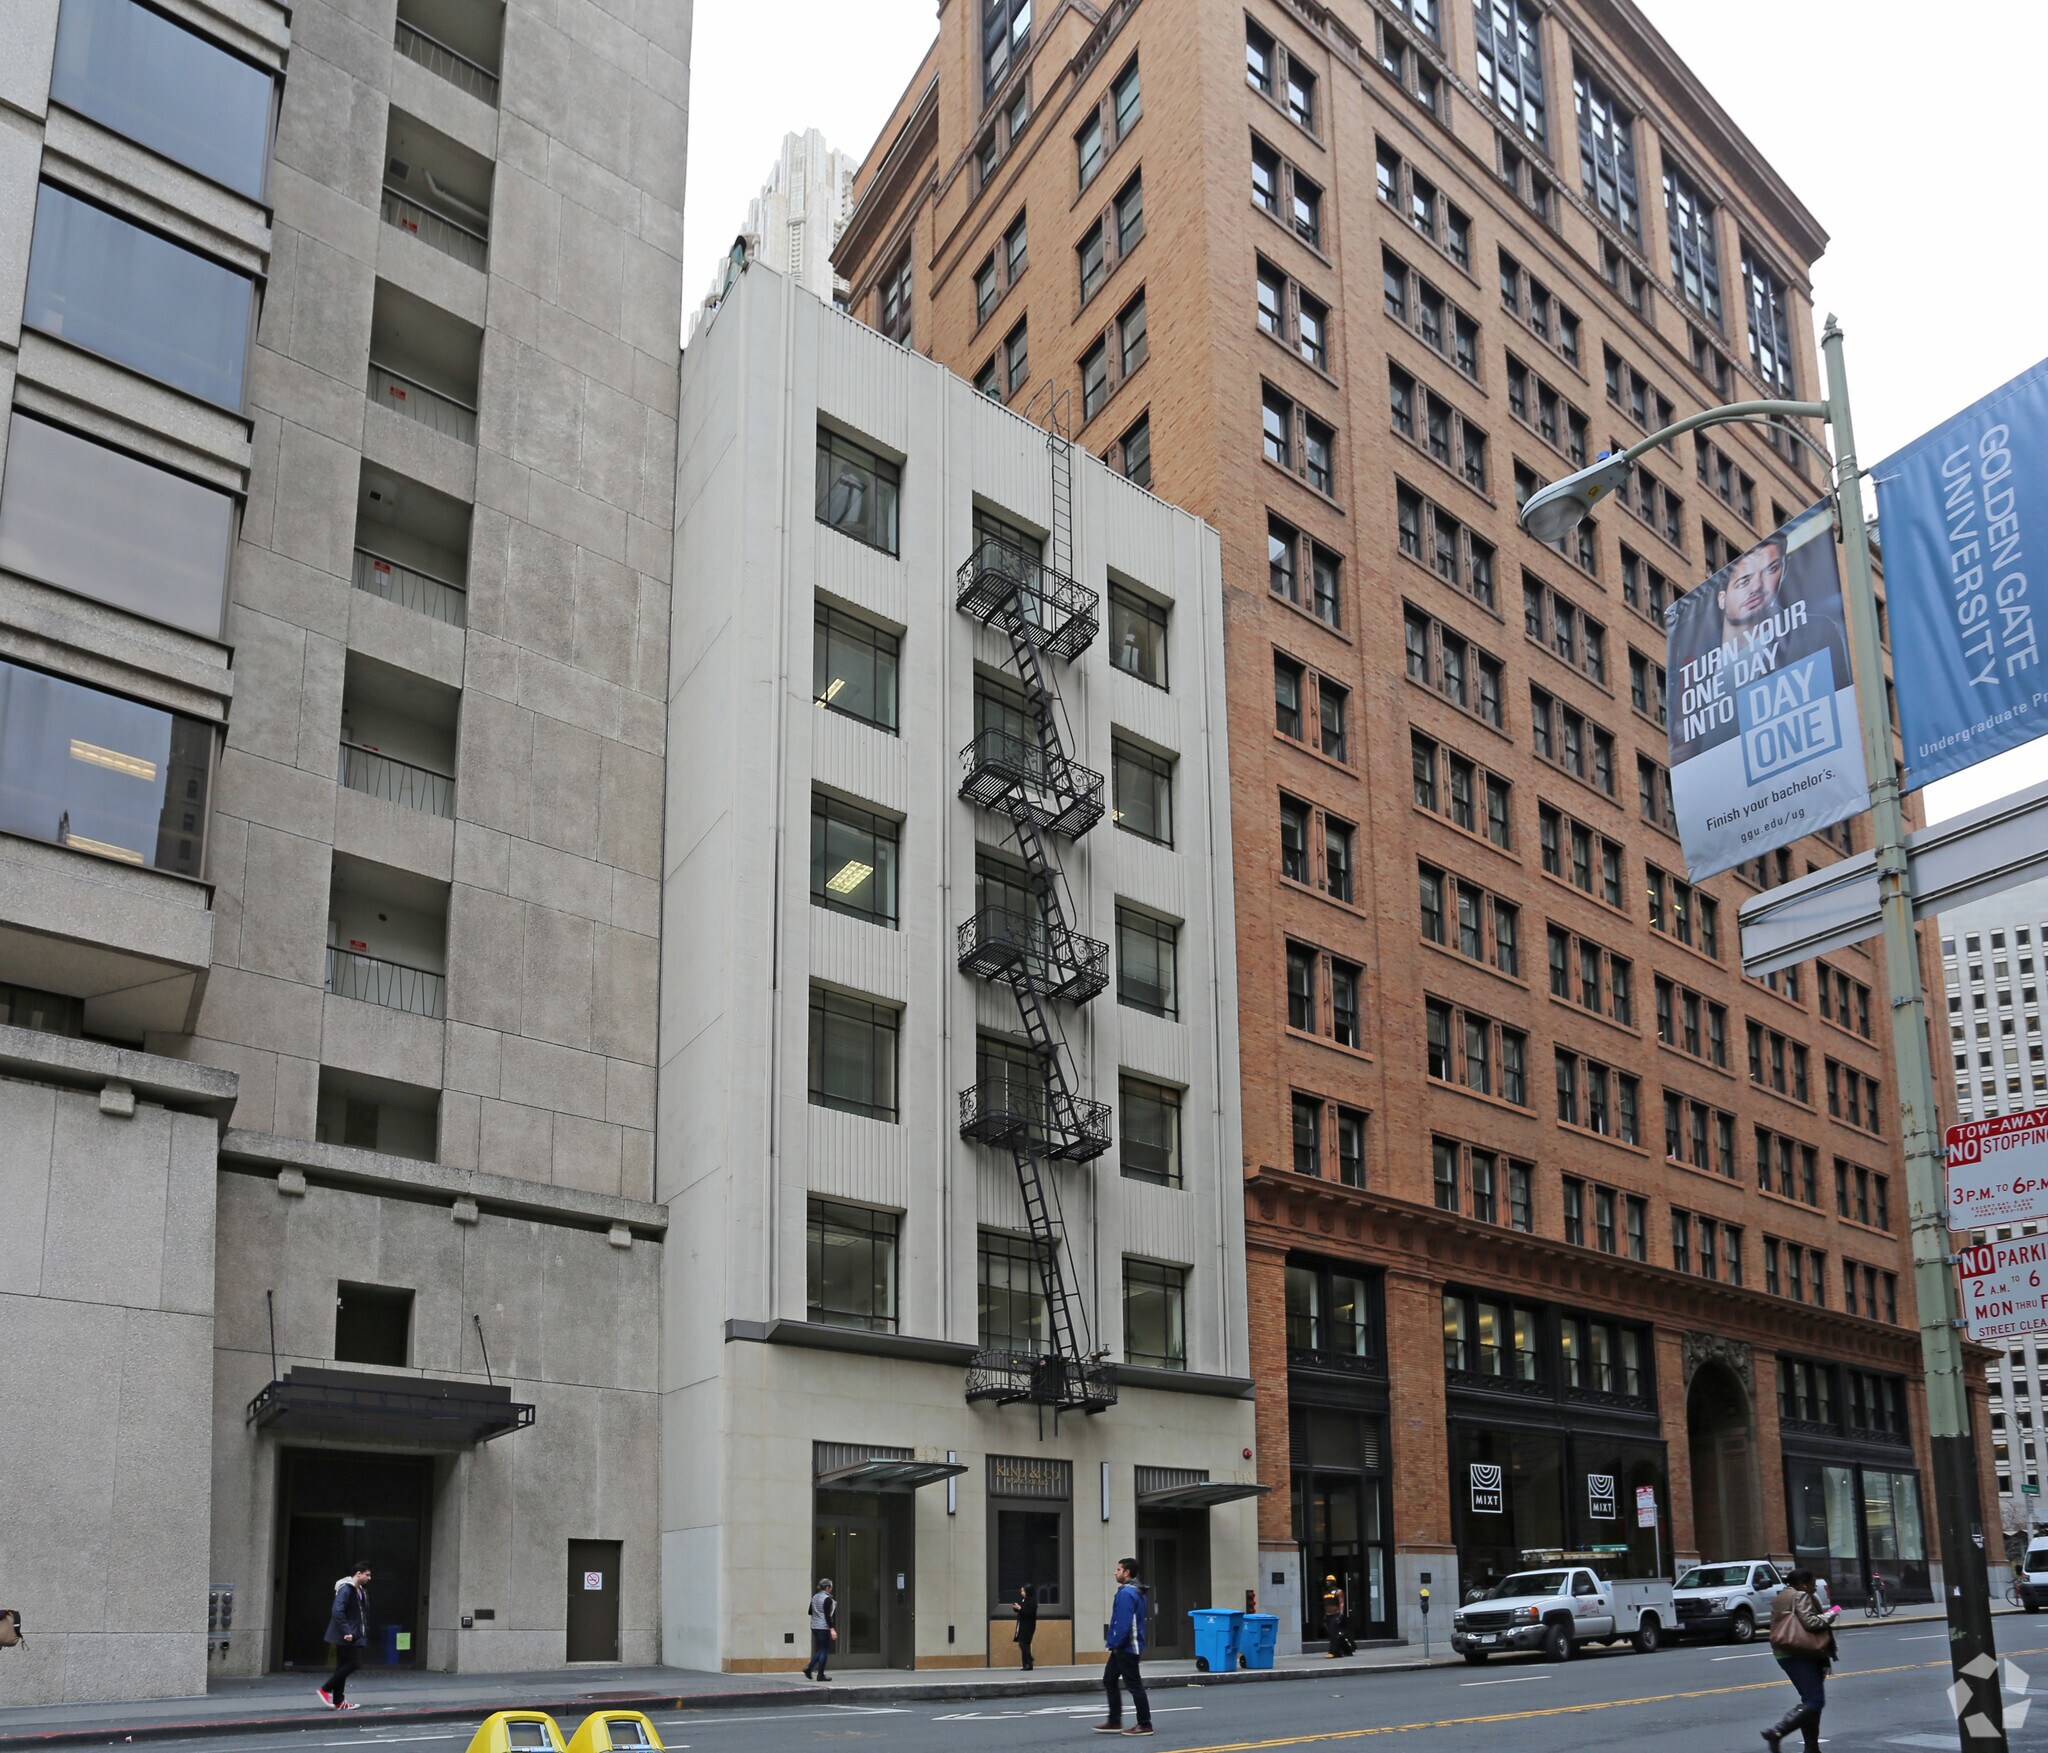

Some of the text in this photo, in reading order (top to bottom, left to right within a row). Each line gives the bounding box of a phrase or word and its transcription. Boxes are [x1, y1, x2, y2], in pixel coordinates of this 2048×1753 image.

[1941, 443, 2000, 687] UNIVERSITY
[1979, 423, 2040, 678] GOLDEN GATE
[1679, 599, 1808, 689] TURN YOUR
[1681, 641, 1779, 716] ONE DAY
[1749, 660, 1815, 727] DAY
[1682, 695, 1735, 743] INTO
[1754, 705, 1826, 769] ONE
[1919, 702, 2028, 758] Undergraduate
[1706, 768, 1837, 831] Finish your bachelor's.
[1740, 808, 1806, 843] ggu.edu/ug
[1956, 1110, 2048, 1140] TOW-AWAY
[1949, 1127, 2048, 1163] NO STOPPIN
[1996, 1183, 2009, 1193] TO
[1961, 1242, 2047, 1275] NO PARKI
[1972, 1269, 2041, 1298] 2 A.M. TO 6
[1975, 1300, 2014, 1320] MON
[2016, 1299, 2038, 1310] THRU
[1979, 1322, 2016, 1337] STREET
[1475, 1494, 1498, 1506] MIXT
[1592, 1502, 1612, 1513] MIXT
